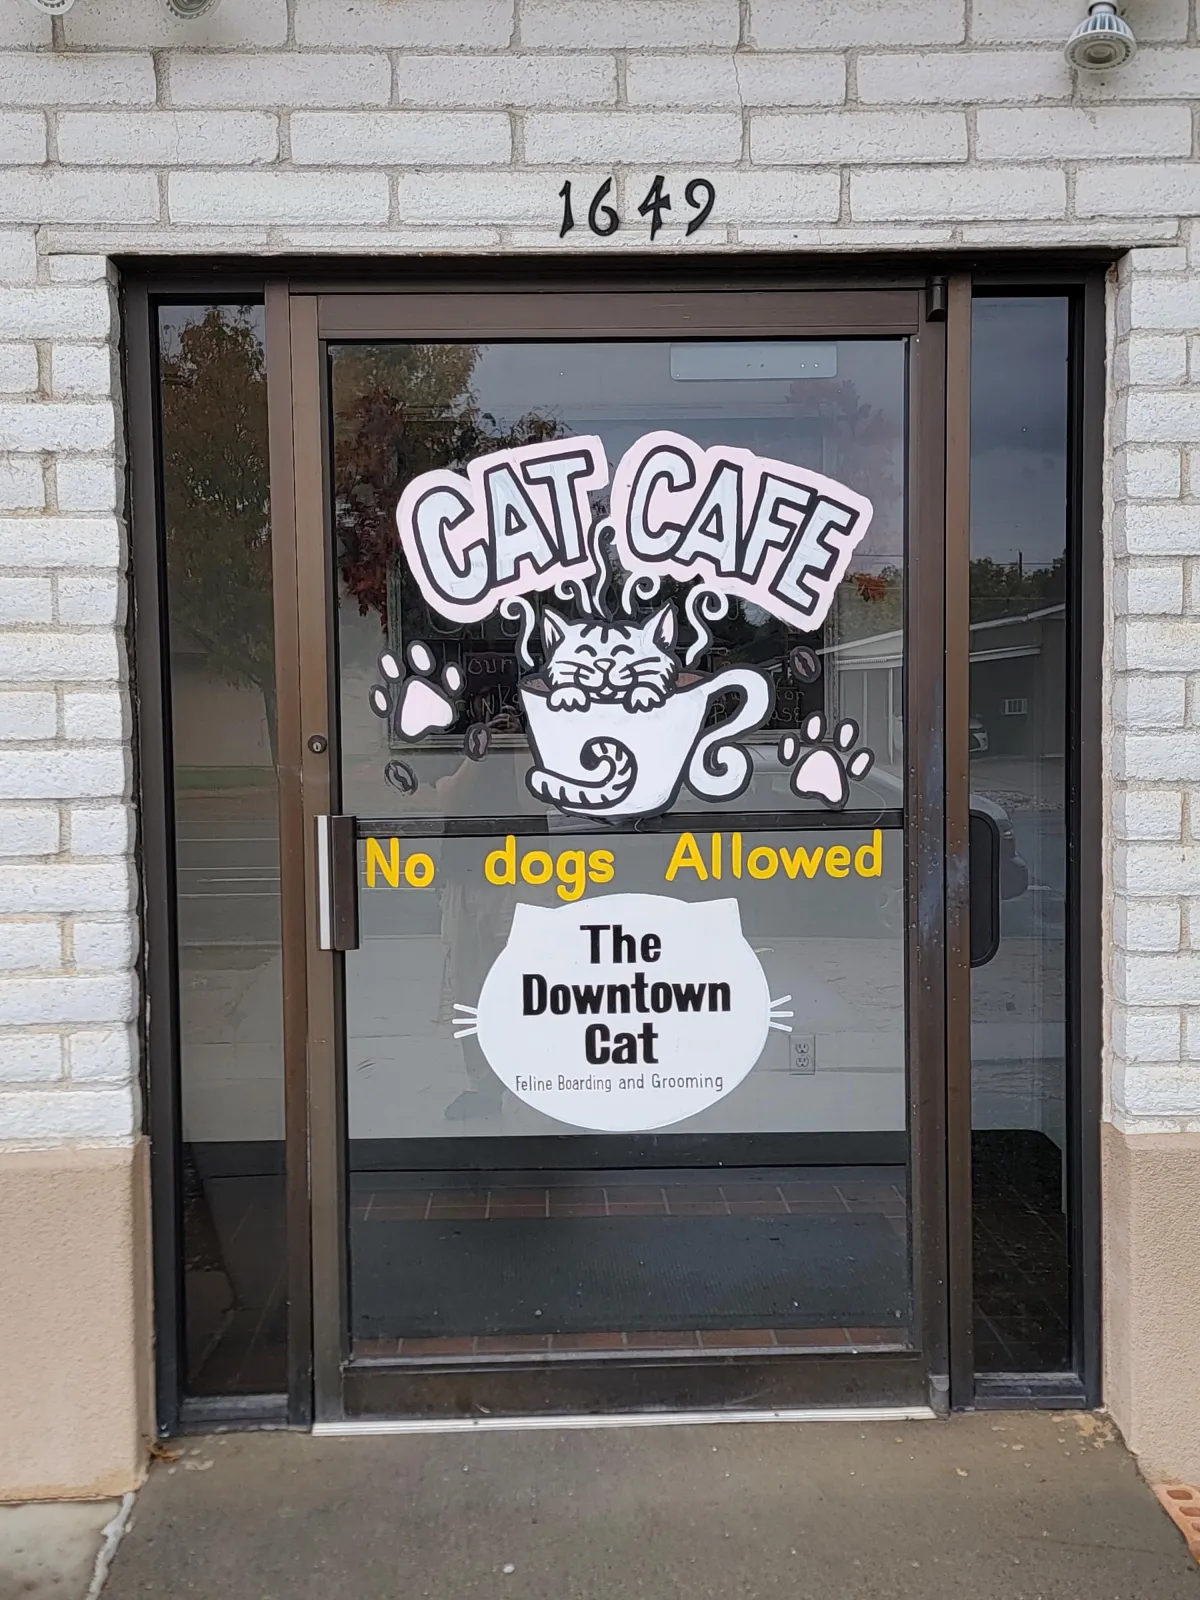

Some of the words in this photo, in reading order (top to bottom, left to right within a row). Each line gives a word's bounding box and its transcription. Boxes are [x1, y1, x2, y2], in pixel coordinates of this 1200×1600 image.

[558, 174, 716, 241] 1649
[411, 448, 595, 605] CAT
[625, 443, 861, 616] CAFE
[366, 837, 435, 888] No
[484, 834, 615, 902] dogs
[665, 828, 883, 881] Allowed
[580, 924, 662, 964] The
[522, 972, 731, 1015] Downtown
[585, 1022, 659, 1065] Cat
[515, 1075, 552, 1092] Feline
[558, 1074, 612, 1093] Boarding
[618, 1073, 644, 1090] and
[651, 1073, 723, 1092] Grooming
